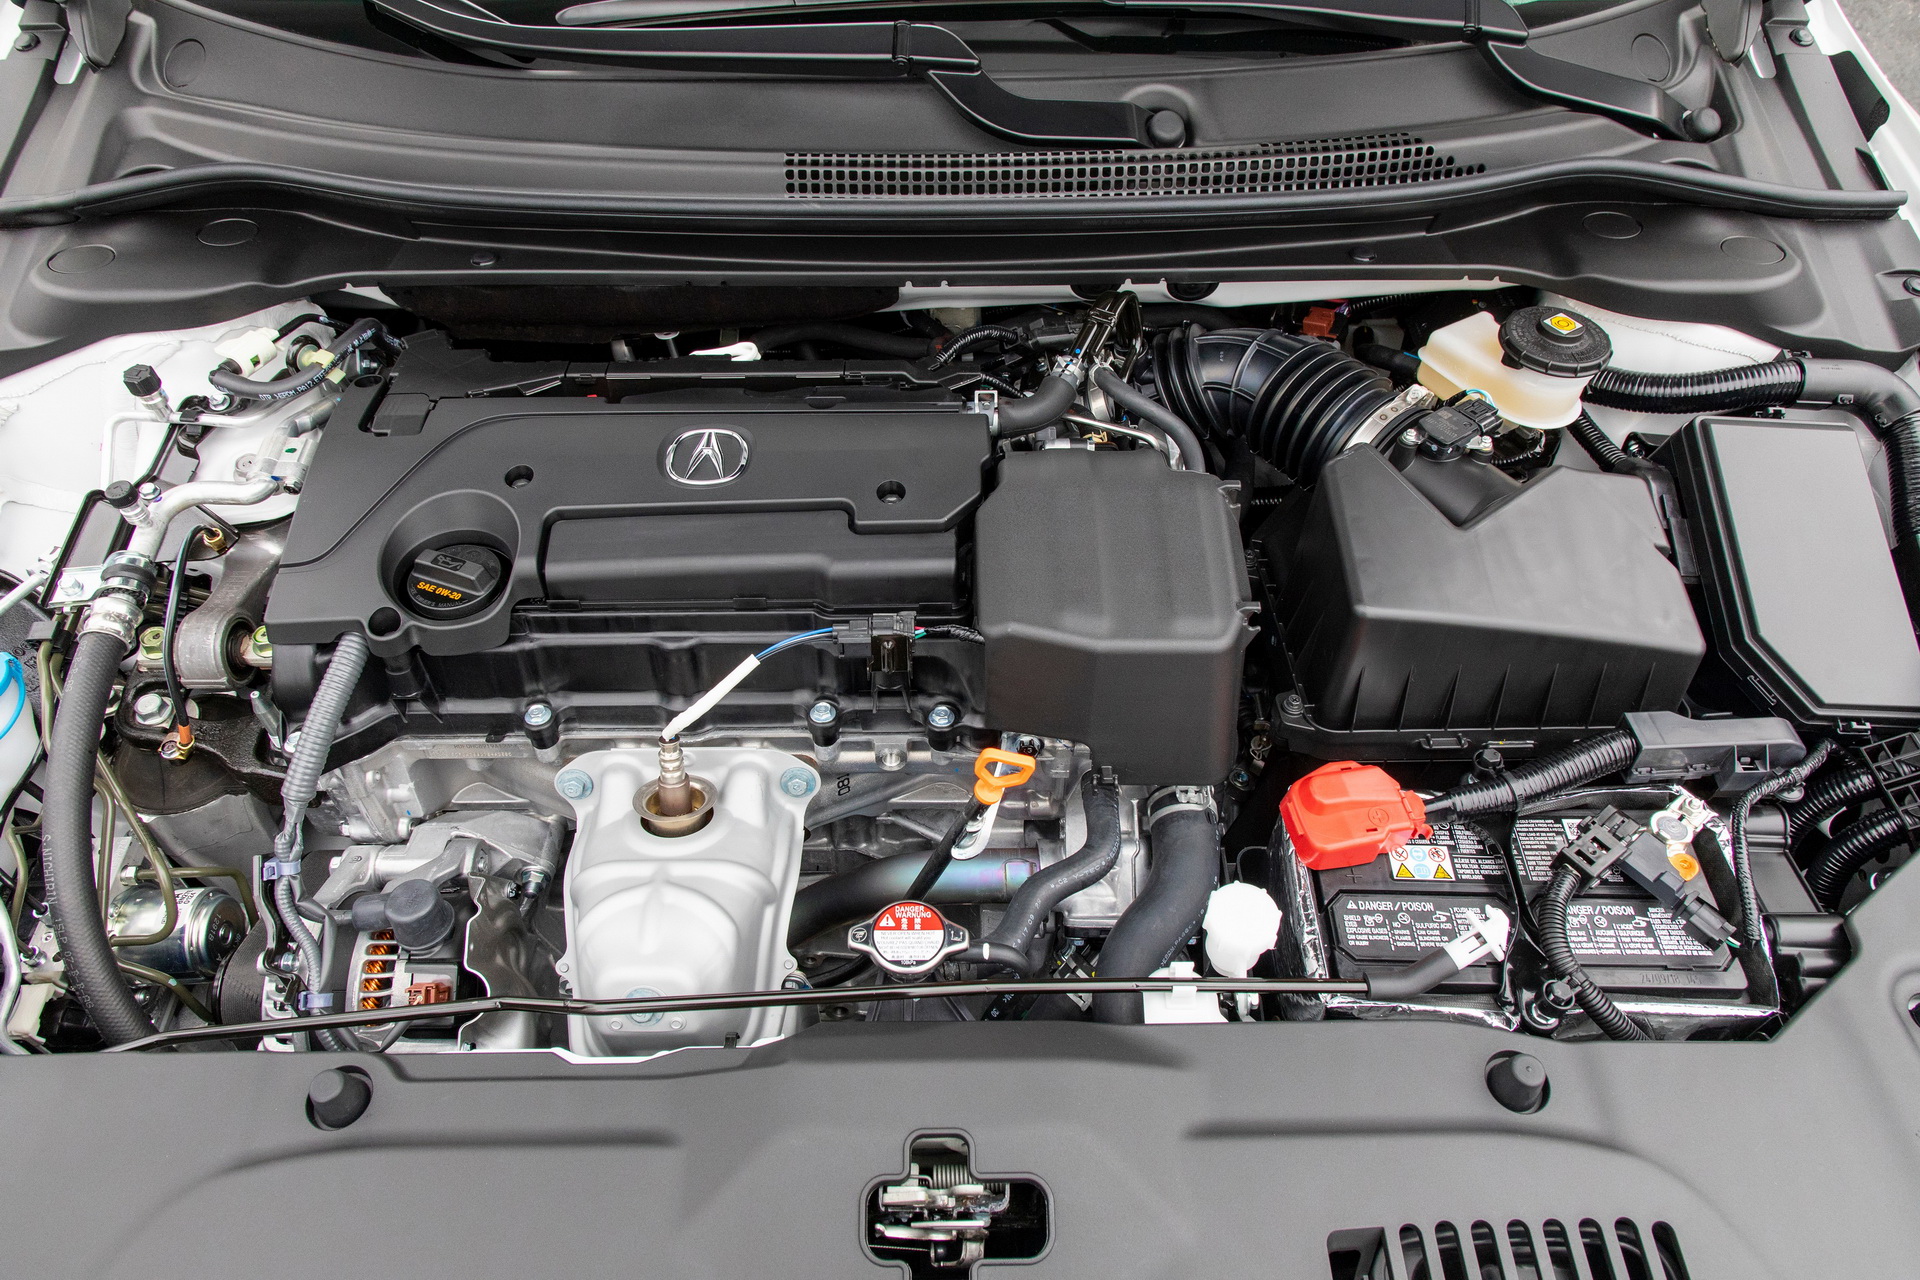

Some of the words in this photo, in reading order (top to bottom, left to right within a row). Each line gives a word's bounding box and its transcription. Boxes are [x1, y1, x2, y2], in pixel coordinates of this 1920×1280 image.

[417, 581, 437, 593] SAE
[435, 587, 462, 600] 0W-20
[1358, 901, 1394, 911] DANGER
[1401, 902, 1435, 912] POISON
[1566, 905, 1594, 915] ANGER
[1601, 905, 1635, 915] POISON
